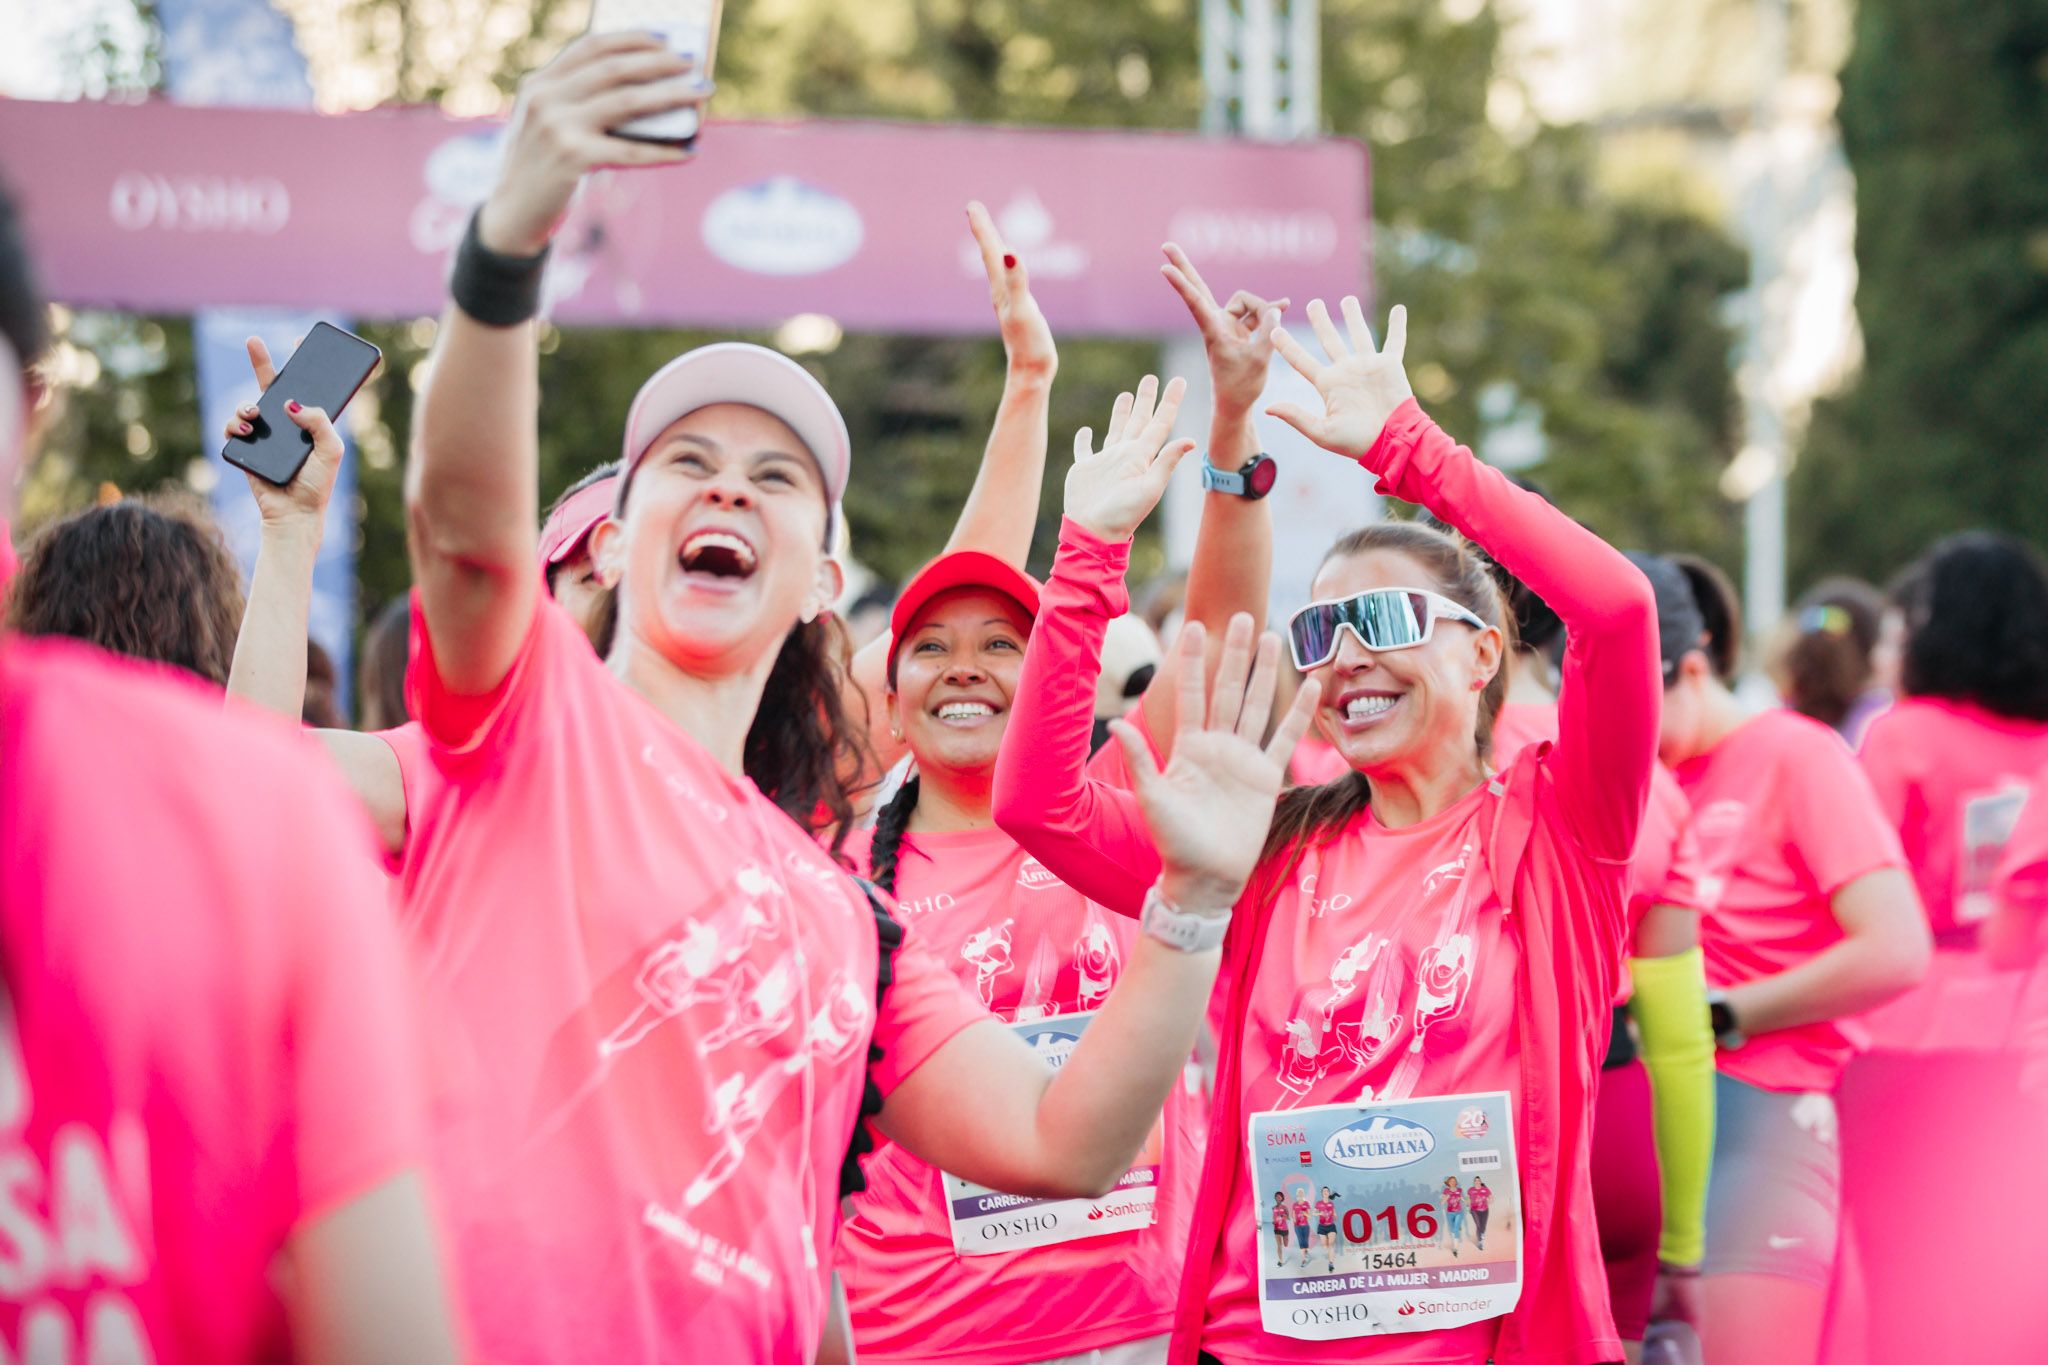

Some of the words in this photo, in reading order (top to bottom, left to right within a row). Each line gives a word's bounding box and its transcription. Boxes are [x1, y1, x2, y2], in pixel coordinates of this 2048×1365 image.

[898, 891, 956, 914] SHO
[1266, 1131, 1307, 1146] SUMA
[981, 1212, 1058, 1240] OYSHO
[1342, 1203, 1438, 1244] 016
[1362, 1251, 1417, 1269] 15464
[1292, 1279, 1347, 1295] CARRERA
[1349, 1276, 1366, 1289] DE
[1368, 1274, 1385, 1287] LA
[1387, 1272, 1430, 1286] MUJER
[1439, 1268, 1489, 1283] MADRID
[1292, 1303, 1368, 1325] OYSHO
[1418, 1298, 1492, 1315] Santander
